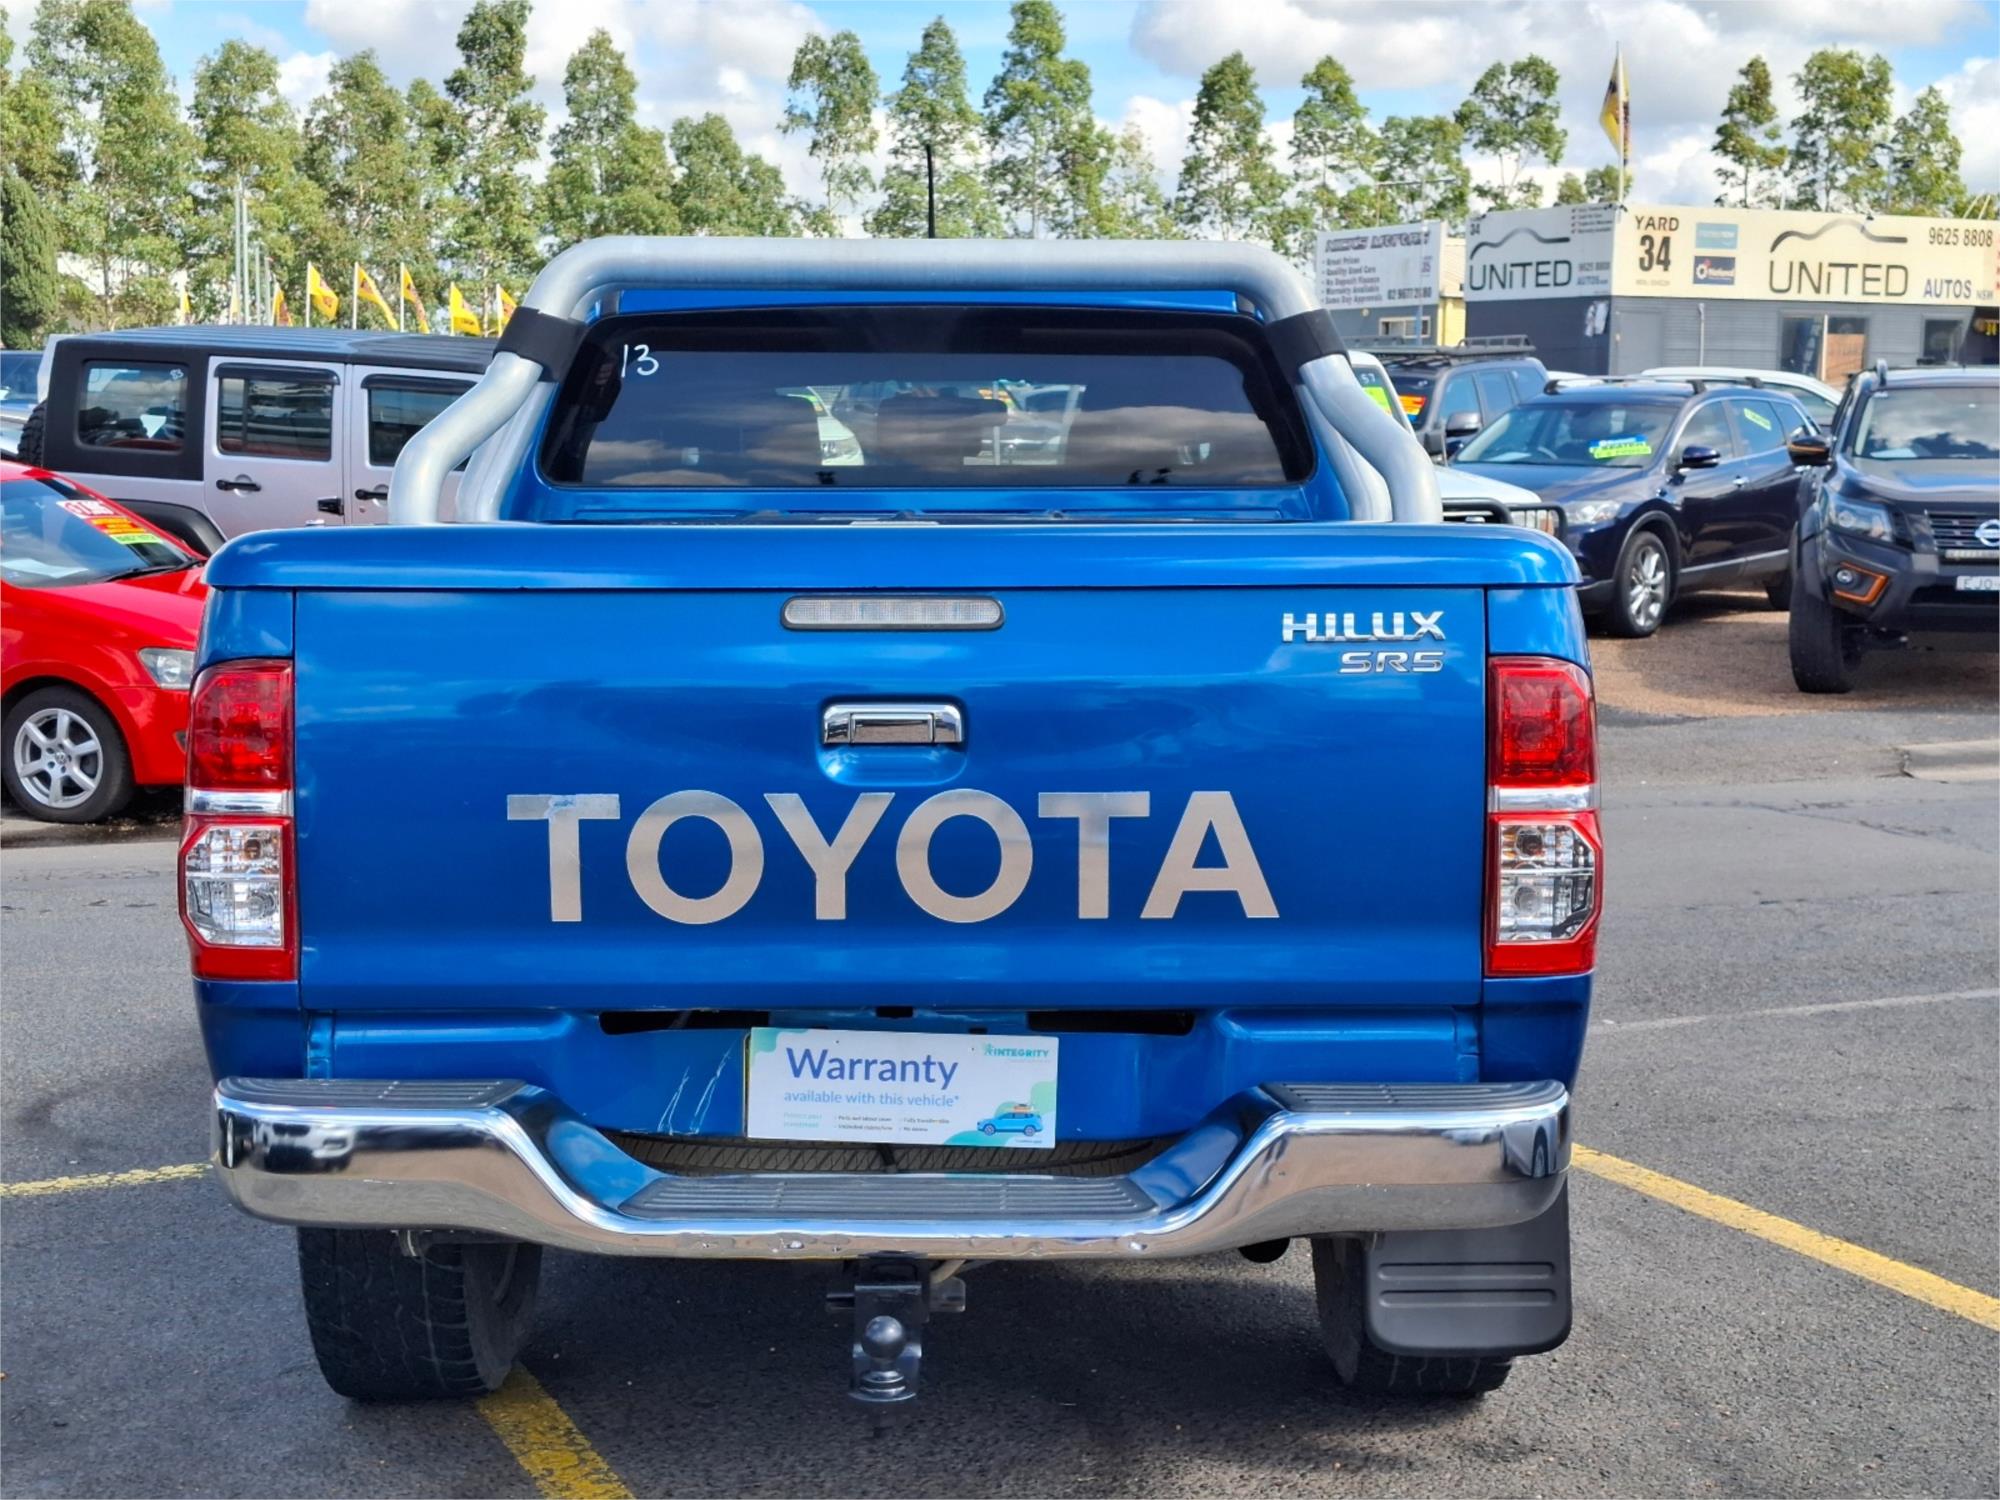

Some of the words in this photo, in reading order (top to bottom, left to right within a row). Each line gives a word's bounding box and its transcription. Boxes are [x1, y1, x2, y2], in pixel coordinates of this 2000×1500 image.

[1635, 216, 1680, 231] YARD
[1929, 227, 1959, 246] 9625
[1964, 229, 1993, 247] 8808
[1639, 234, 1671, 272] 34
[1924, 279, 1972, 299] AUTOS
[621, 344, 659, 378] 13
[1282, 610, 1446, 642] HILUX
[1339, 652, 1444, 673] SR5
[506, 788, 1280, 925] TOYOTA
[994, 1048, 1049, 1057] INTEGRITY
[786, 1047, 958, 1090] Warranty
[784, 1090, 842, 1104] available
[846, 1090, 876, 1104] with
[879, 1092, 903, 1105] this
